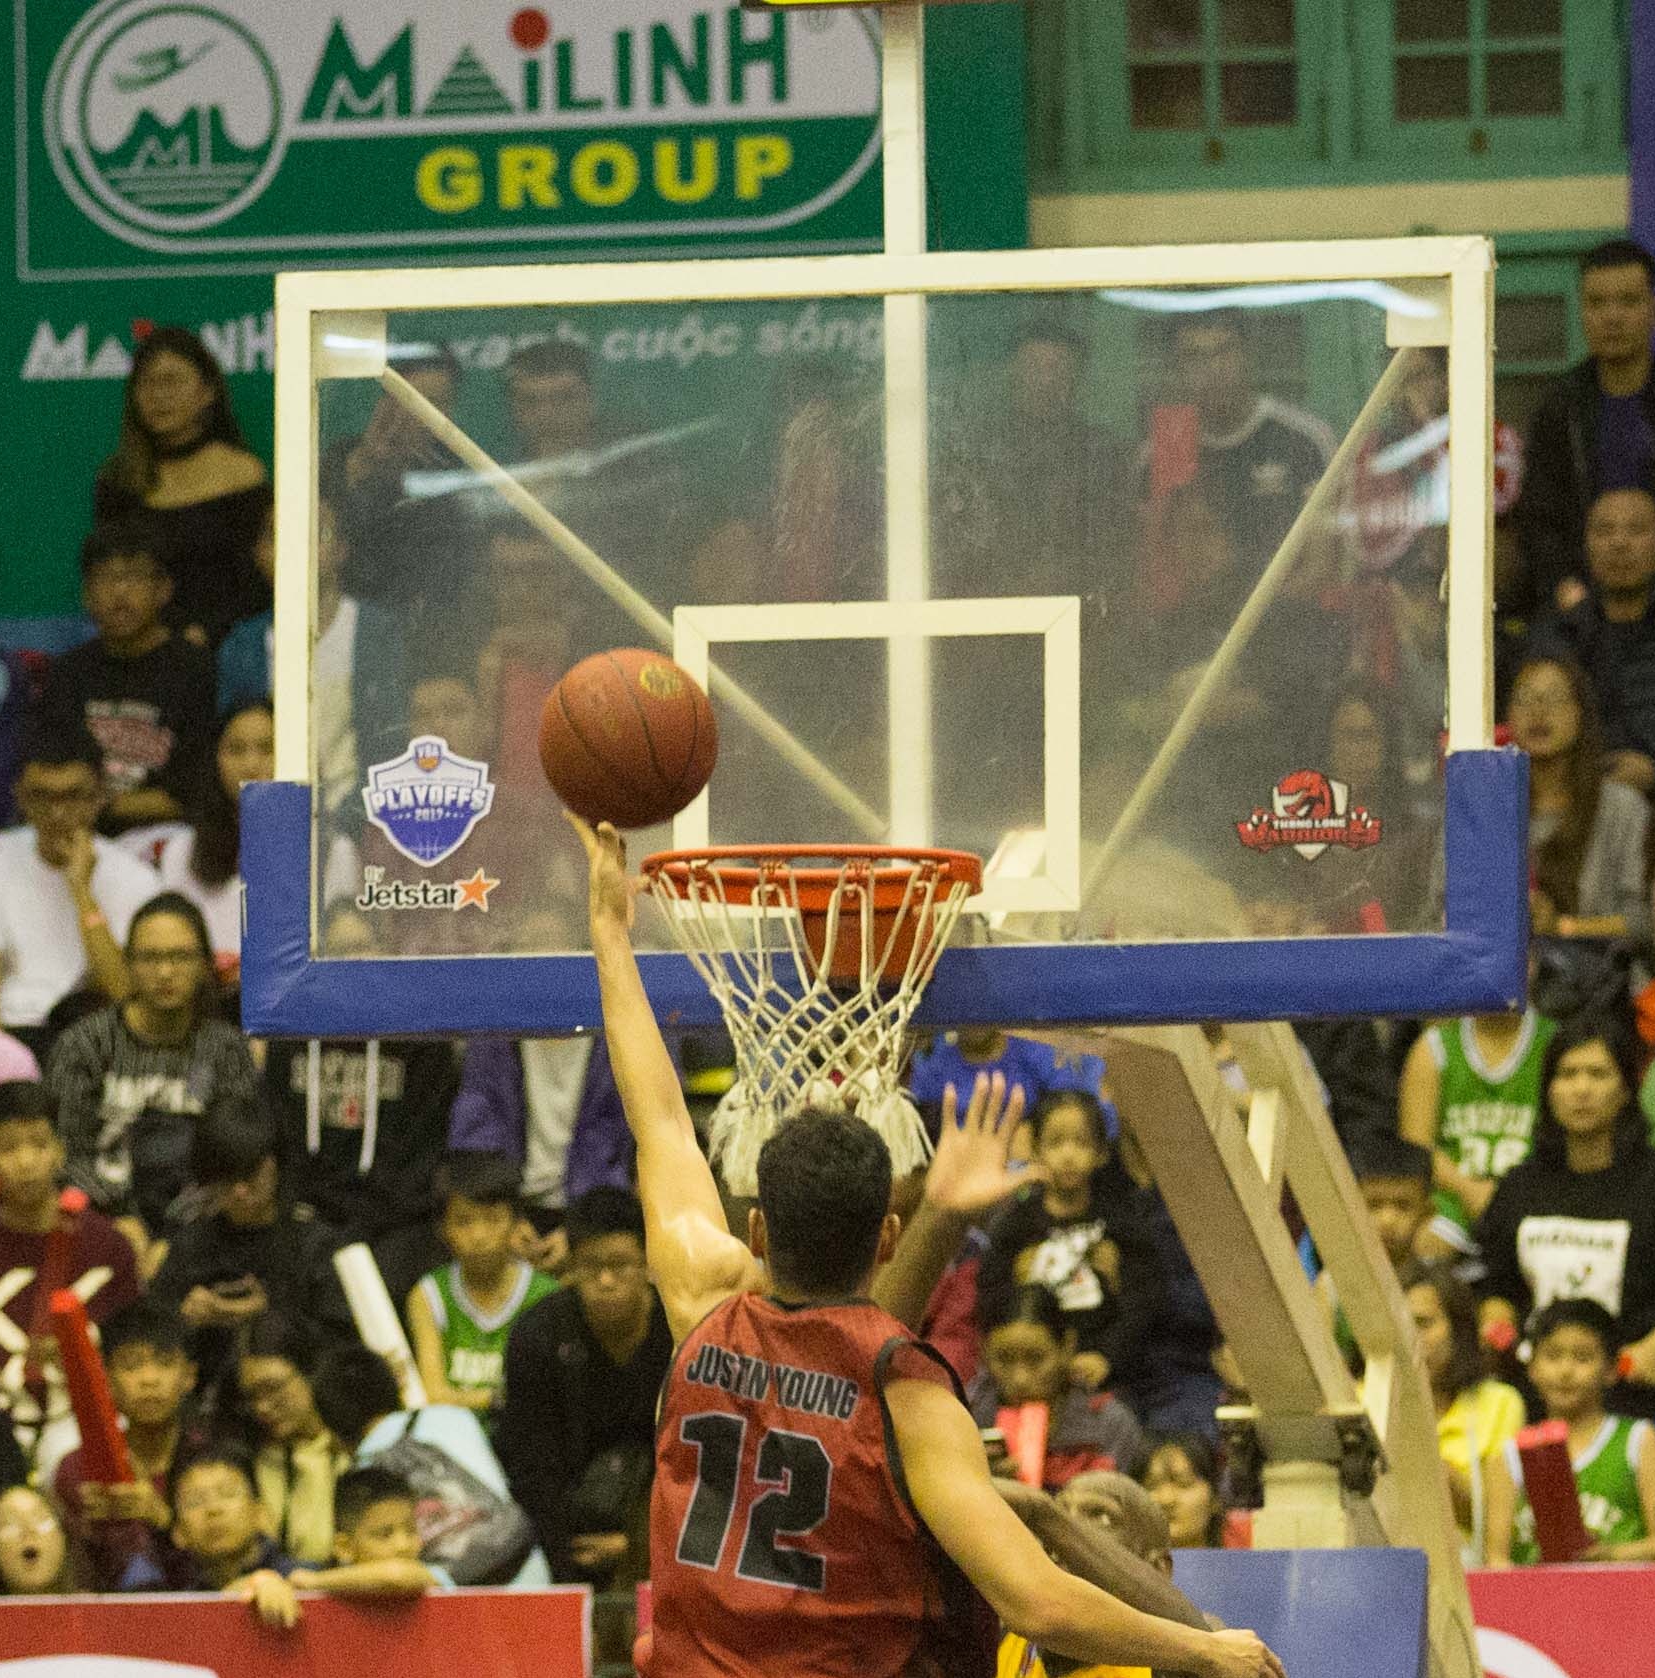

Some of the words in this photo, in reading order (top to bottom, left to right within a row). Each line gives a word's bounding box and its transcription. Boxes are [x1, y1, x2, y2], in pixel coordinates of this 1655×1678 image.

[414, 134, 792, 213] GROUP
[371, 784, 486, 811] PLAYOFFS
[357, 882, 458, 908] Jetstar
[686, 1343, 770, 1402] JUSTN
[774, 1364, 859, 1421] YOUNG
[675, 1411, 833, 1592] 12
